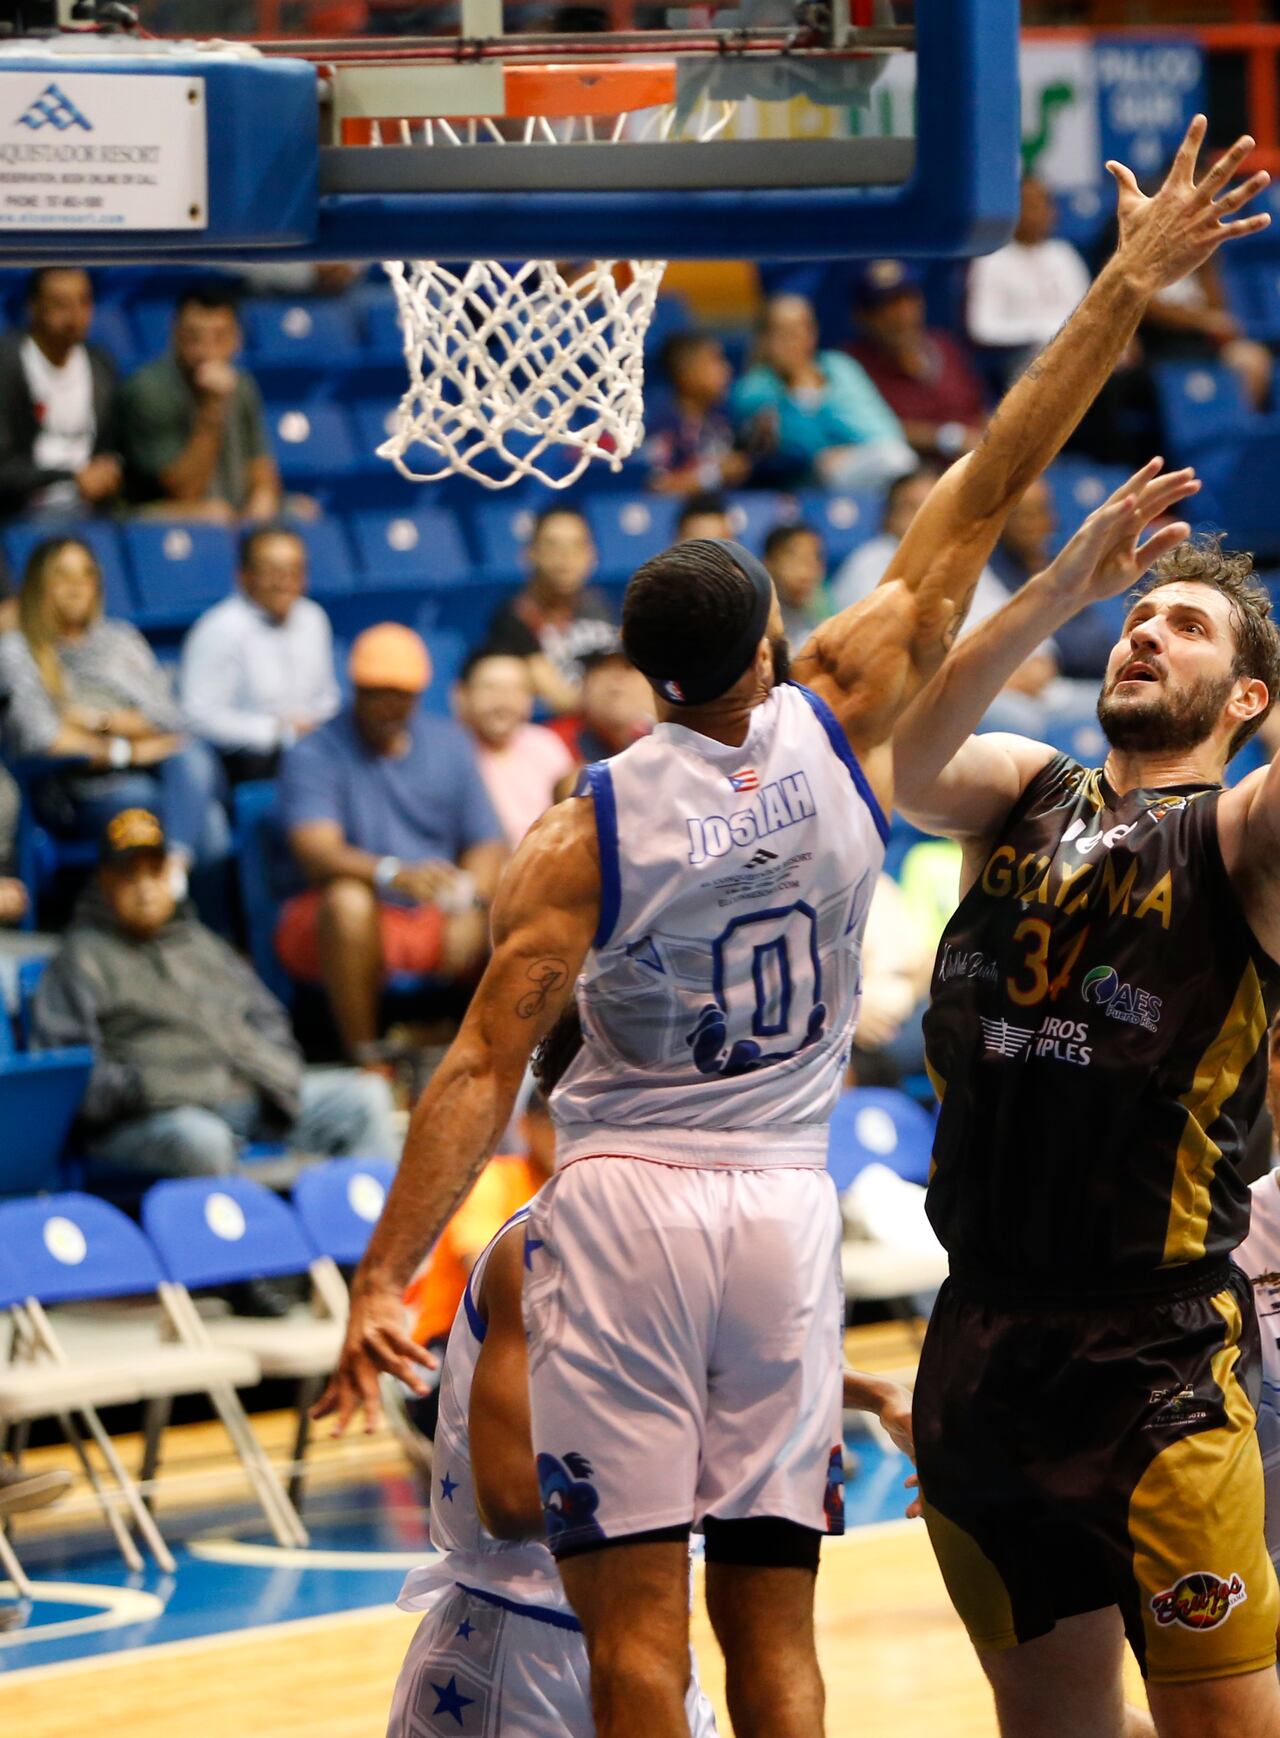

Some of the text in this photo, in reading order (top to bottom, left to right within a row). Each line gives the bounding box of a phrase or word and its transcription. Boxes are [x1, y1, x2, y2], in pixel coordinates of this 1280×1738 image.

[100, 144, 161, 164] RESORT
[686, 770, 817, 864] JOSIAH
[712, 899, 822, 1062] 0
[1109, 983, 1163, 1023] AES
[1151, 1575, 1243, 1625] Brujos
